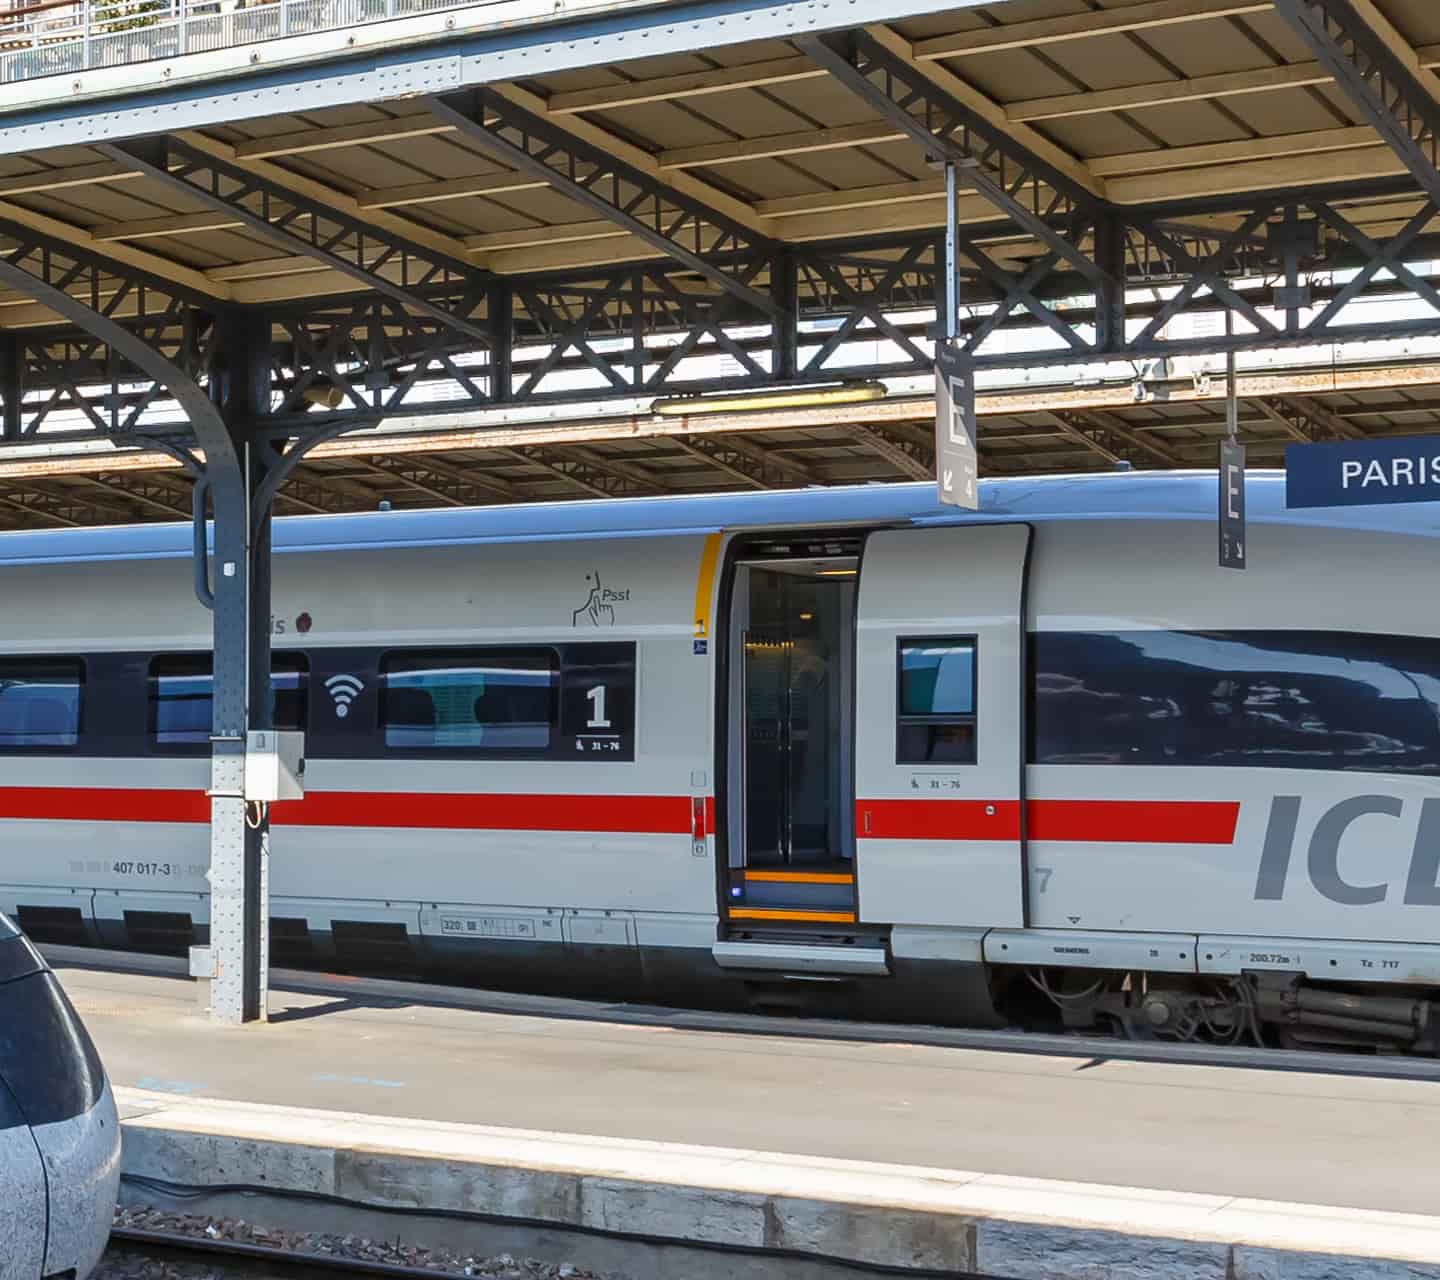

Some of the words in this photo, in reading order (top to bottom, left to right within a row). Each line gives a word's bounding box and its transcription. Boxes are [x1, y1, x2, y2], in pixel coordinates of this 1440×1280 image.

[949, 375, 967, 447] E
[1227, 464, 1240, 519] E
[601, 588, 631, 601] Psst
[696, 618, 705, 635] 1
[586, 684, 612, 728] 1
[112, 861, 133, 874] 407
[137, 862, 170, 875] 017-3
[1034, 867, 1053, 894] 7
